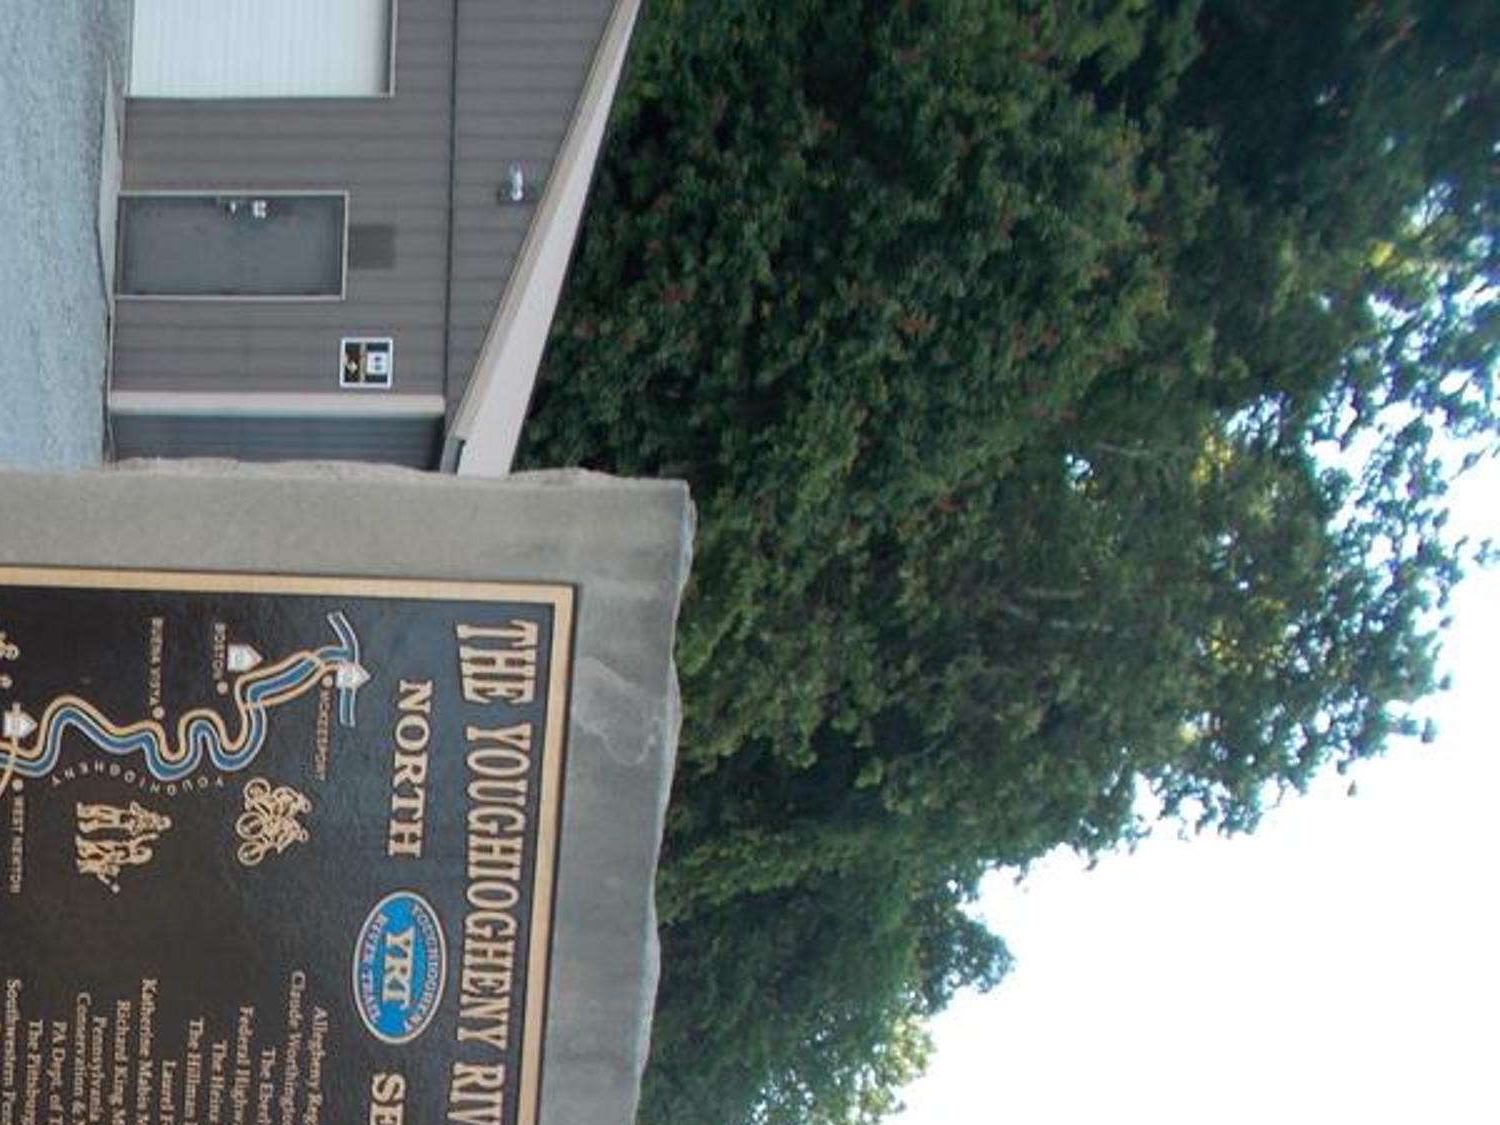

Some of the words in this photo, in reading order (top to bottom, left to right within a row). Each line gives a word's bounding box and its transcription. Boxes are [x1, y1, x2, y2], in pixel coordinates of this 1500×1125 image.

[213, 623, 226, 680] BOSTON
[457, 620, 539, 704] THE
[387, 680, 433, 858] NORTH
[12, 796, 24, 833] WEST
[10, 837, 23, 893] NEWTON
[457, 722, 532, 1049] YOUGHIOGHENY
[362, 913, 388, 965] RIVER
[362, 966, 381, 1023] TRAIL
[382, 926, 416, 1011] YRT
[139, 979, 157, 1056] Katherine
[289, 971, 306, 1028] Claude
[3, 979, 22, 1087] Southwestern
[27, 1020, 43, 1050] The
[52, 1021, 68, 1043] PA
[74, 991, 91, 1096] Conservation
[114, 1000, 131, 1060] Richard
[188, 1018, 204, 1050] The
[212, 1040, 228, 1073] The
[236, 1006, 254, 1065] Federal
[307, 1006, 328, 1089] Allegheny
[88, 1016, 108, 1121] Pennsylvania
[109, 1064, 128, 1106] King
[161, 1060, 177, 1111] Laurel
[185, 1052, 202, 1117] Hillman
[261, 1047, 276, 1080] The
[49, 1094, 63, 1111] of
[72, 1100, 85, 1115] &
